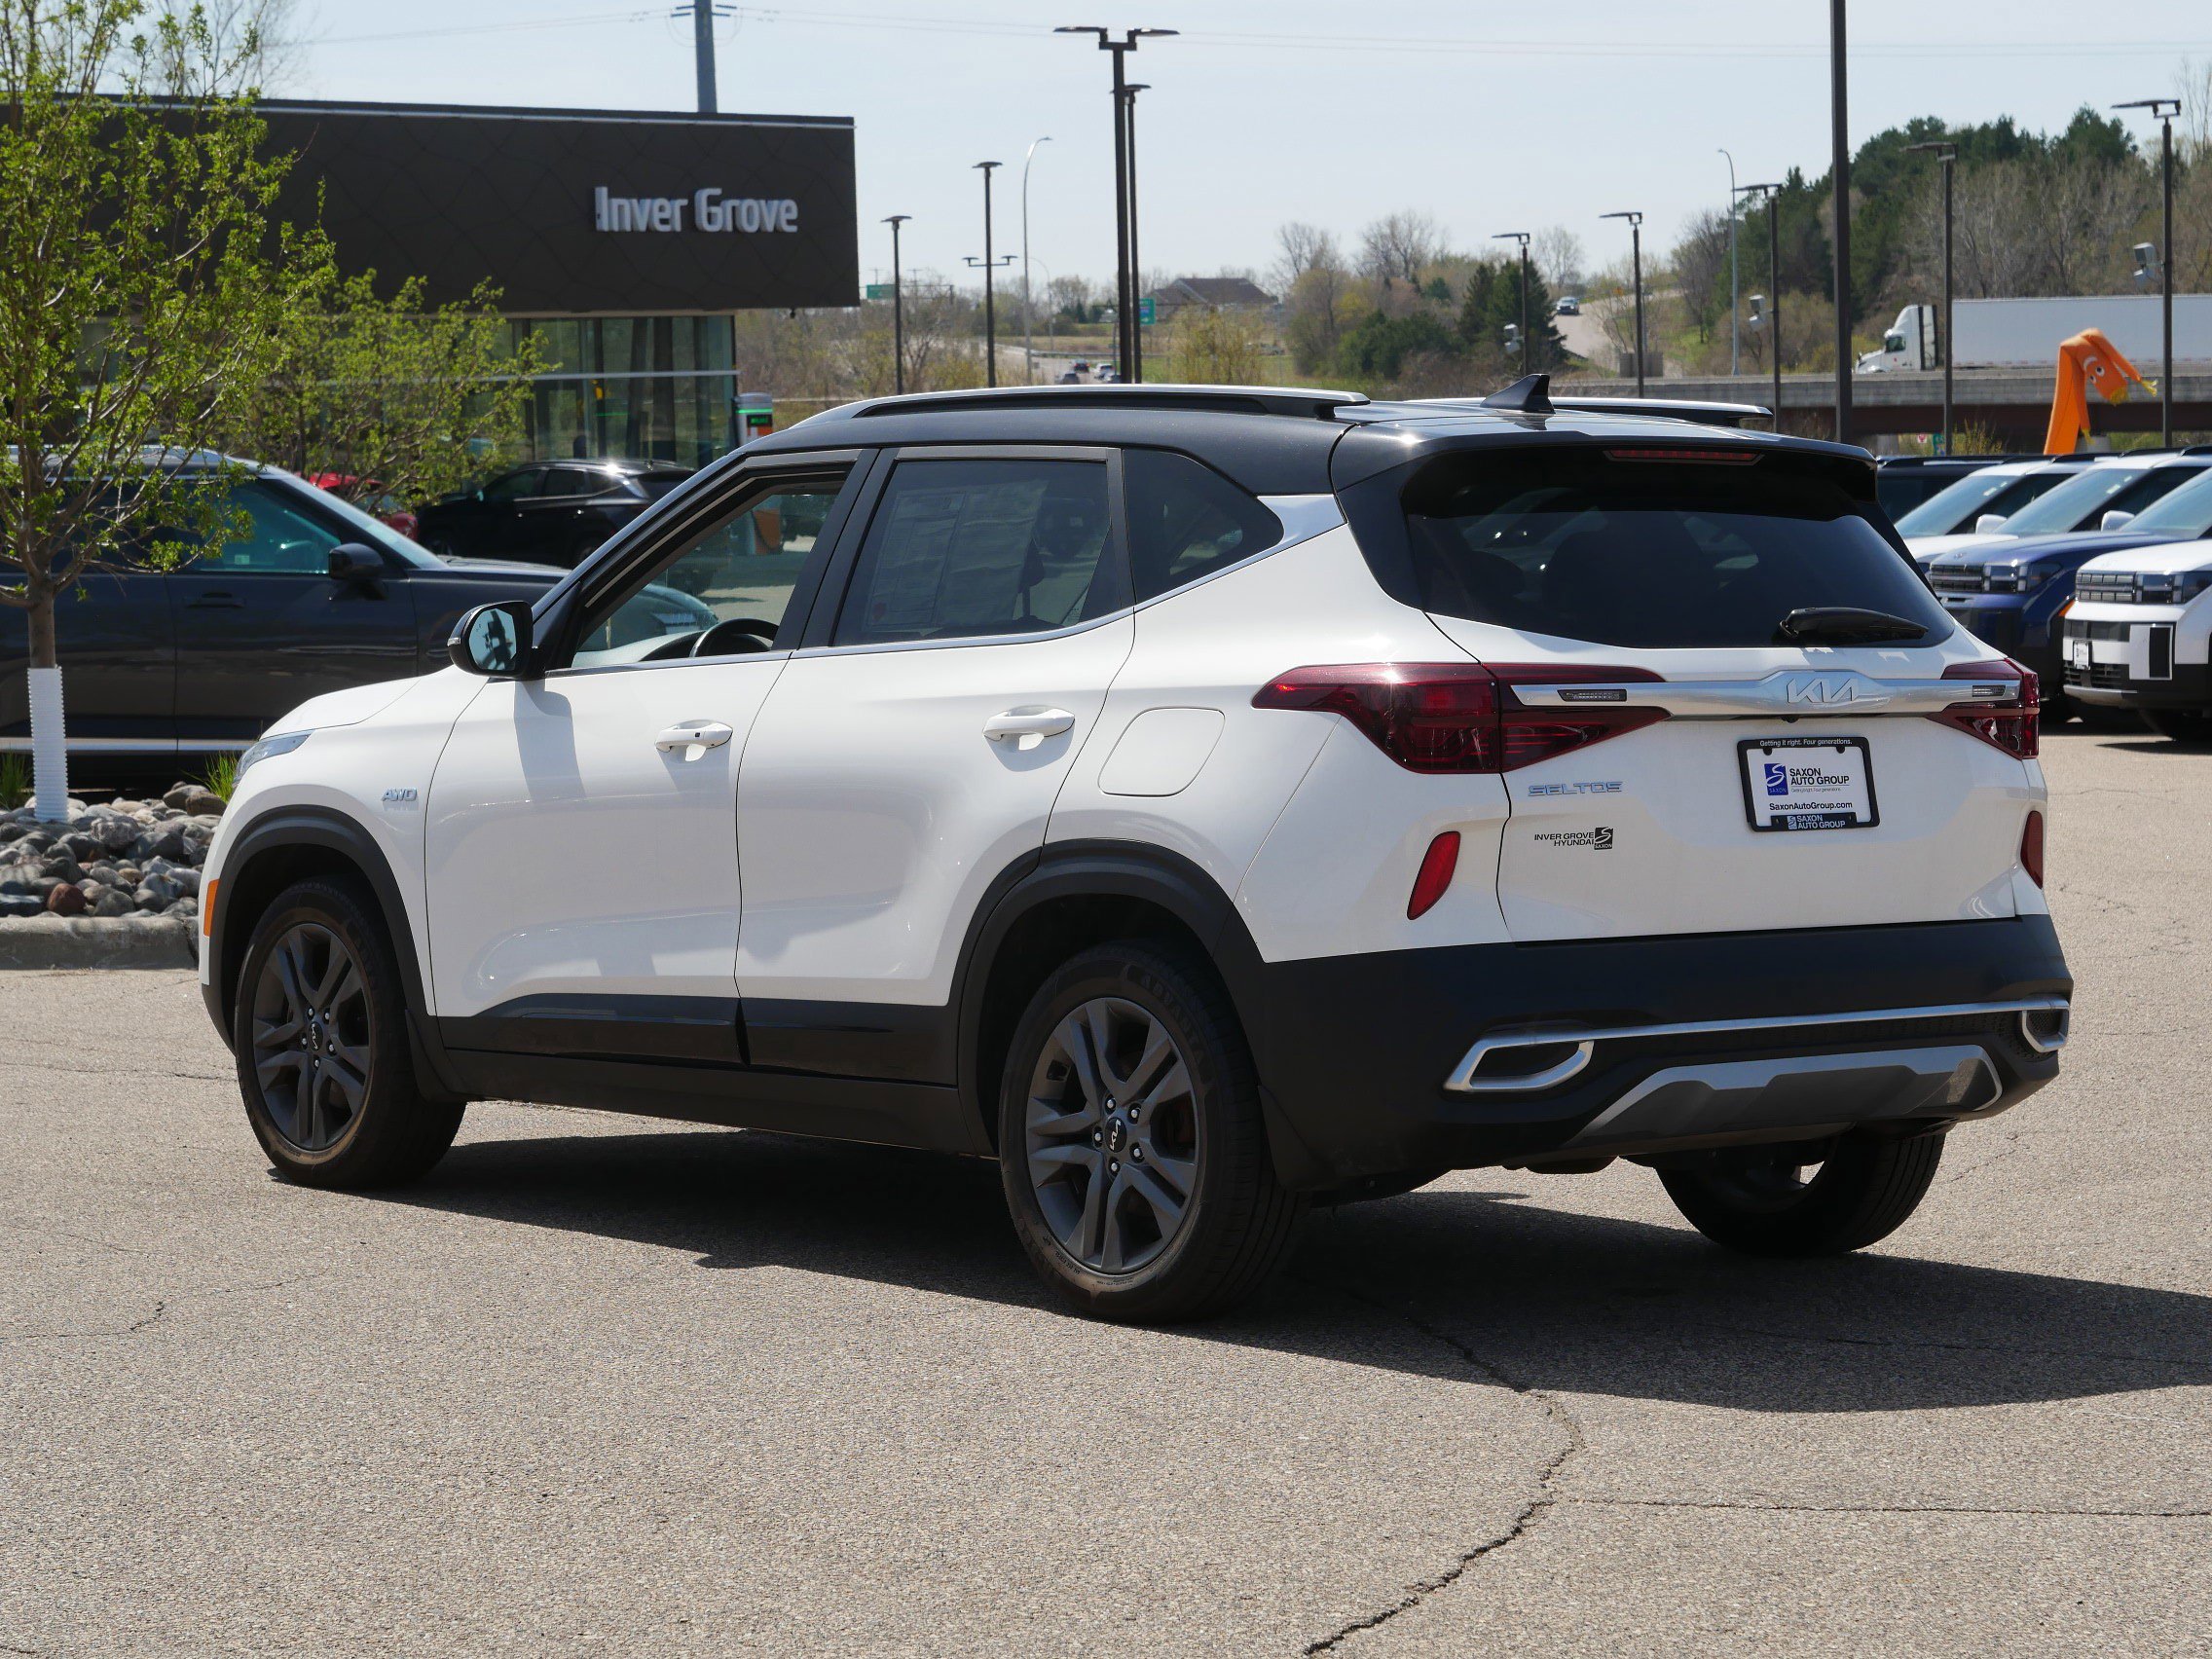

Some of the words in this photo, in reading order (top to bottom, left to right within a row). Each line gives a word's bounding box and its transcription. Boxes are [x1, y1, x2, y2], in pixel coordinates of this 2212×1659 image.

[594, 186, 688, 232] Inver
[694, 188, 798, 233] Grove
[1786, 678, 1860, 703] KIA
[1789, 768, 1821, 777] SAXON
[1790, 776, 1815, 786] AUTO
[1817, 775, 1850, 785] GROUP
[382, 788, 418, 801] AWD
[1528, 781, 1623, 796] SELTOS
[1769, 801, 1853, 811] SaxonAutoGroup.com
[1796, 814, 1823, 823] SAXON
